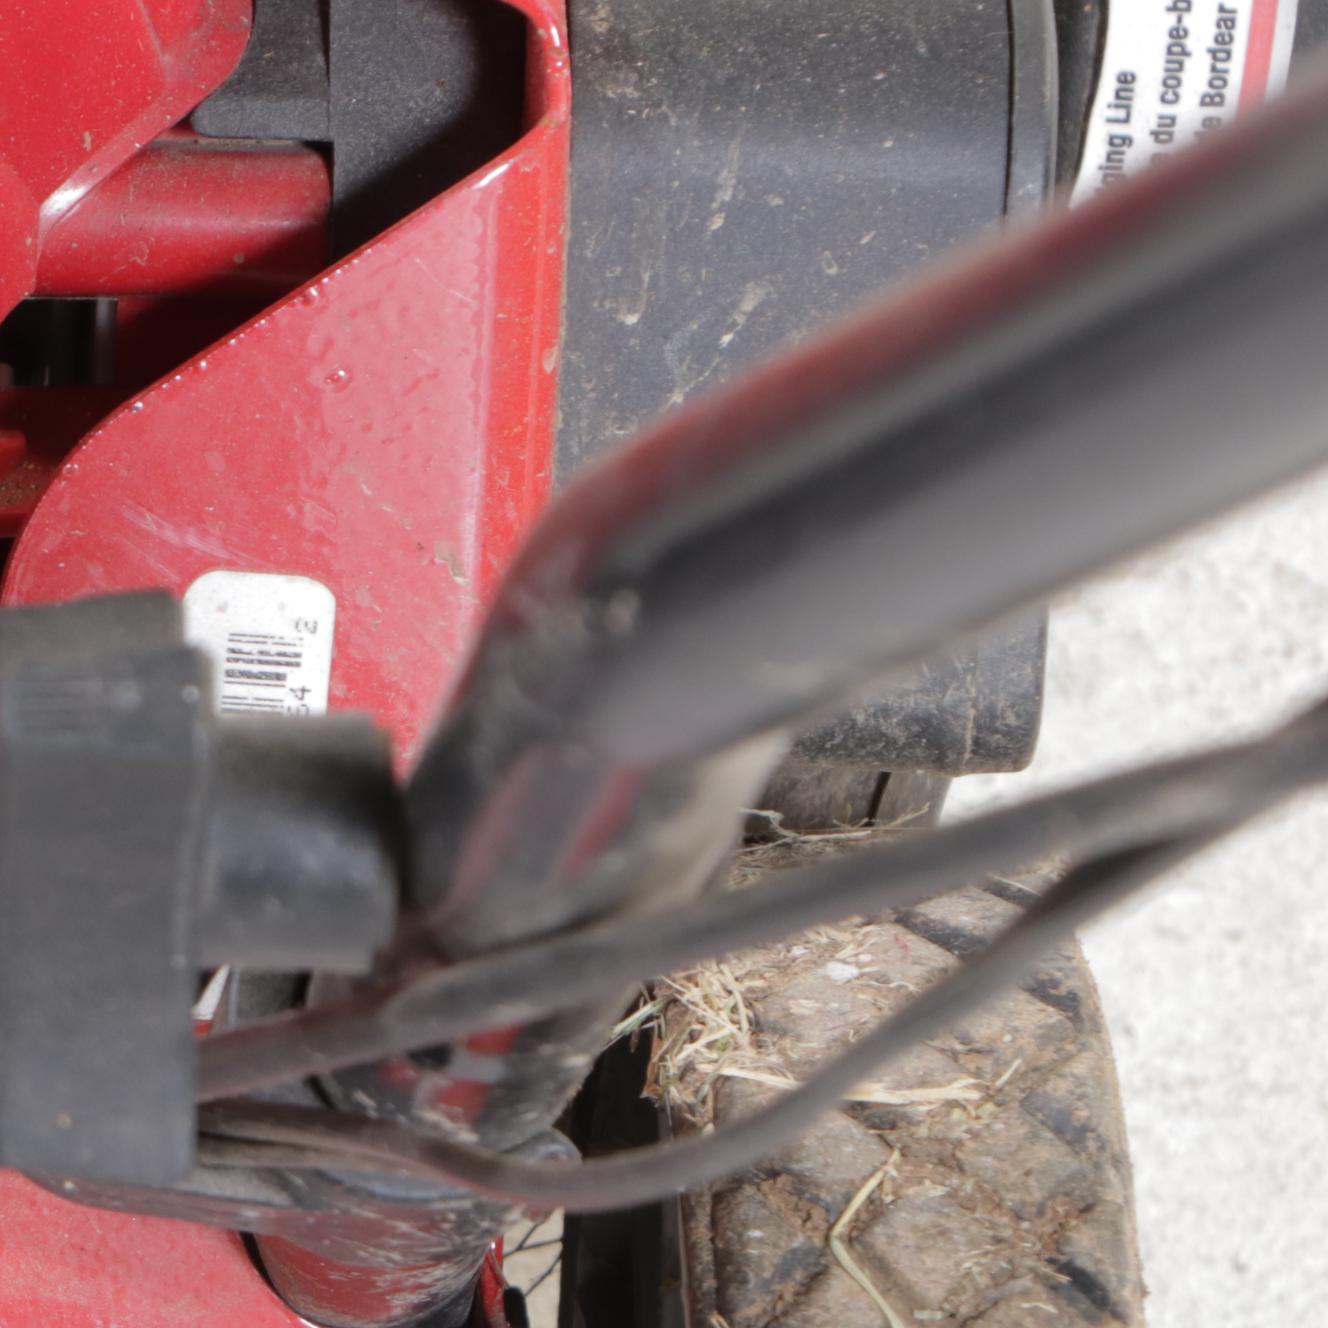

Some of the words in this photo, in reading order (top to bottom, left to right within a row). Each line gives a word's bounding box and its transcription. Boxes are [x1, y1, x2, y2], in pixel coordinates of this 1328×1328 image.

[1198, 3, 1237, 107] Bordear
[1105, 70, 1136, 125] Line
[1149, 113, 1176, 145] du
